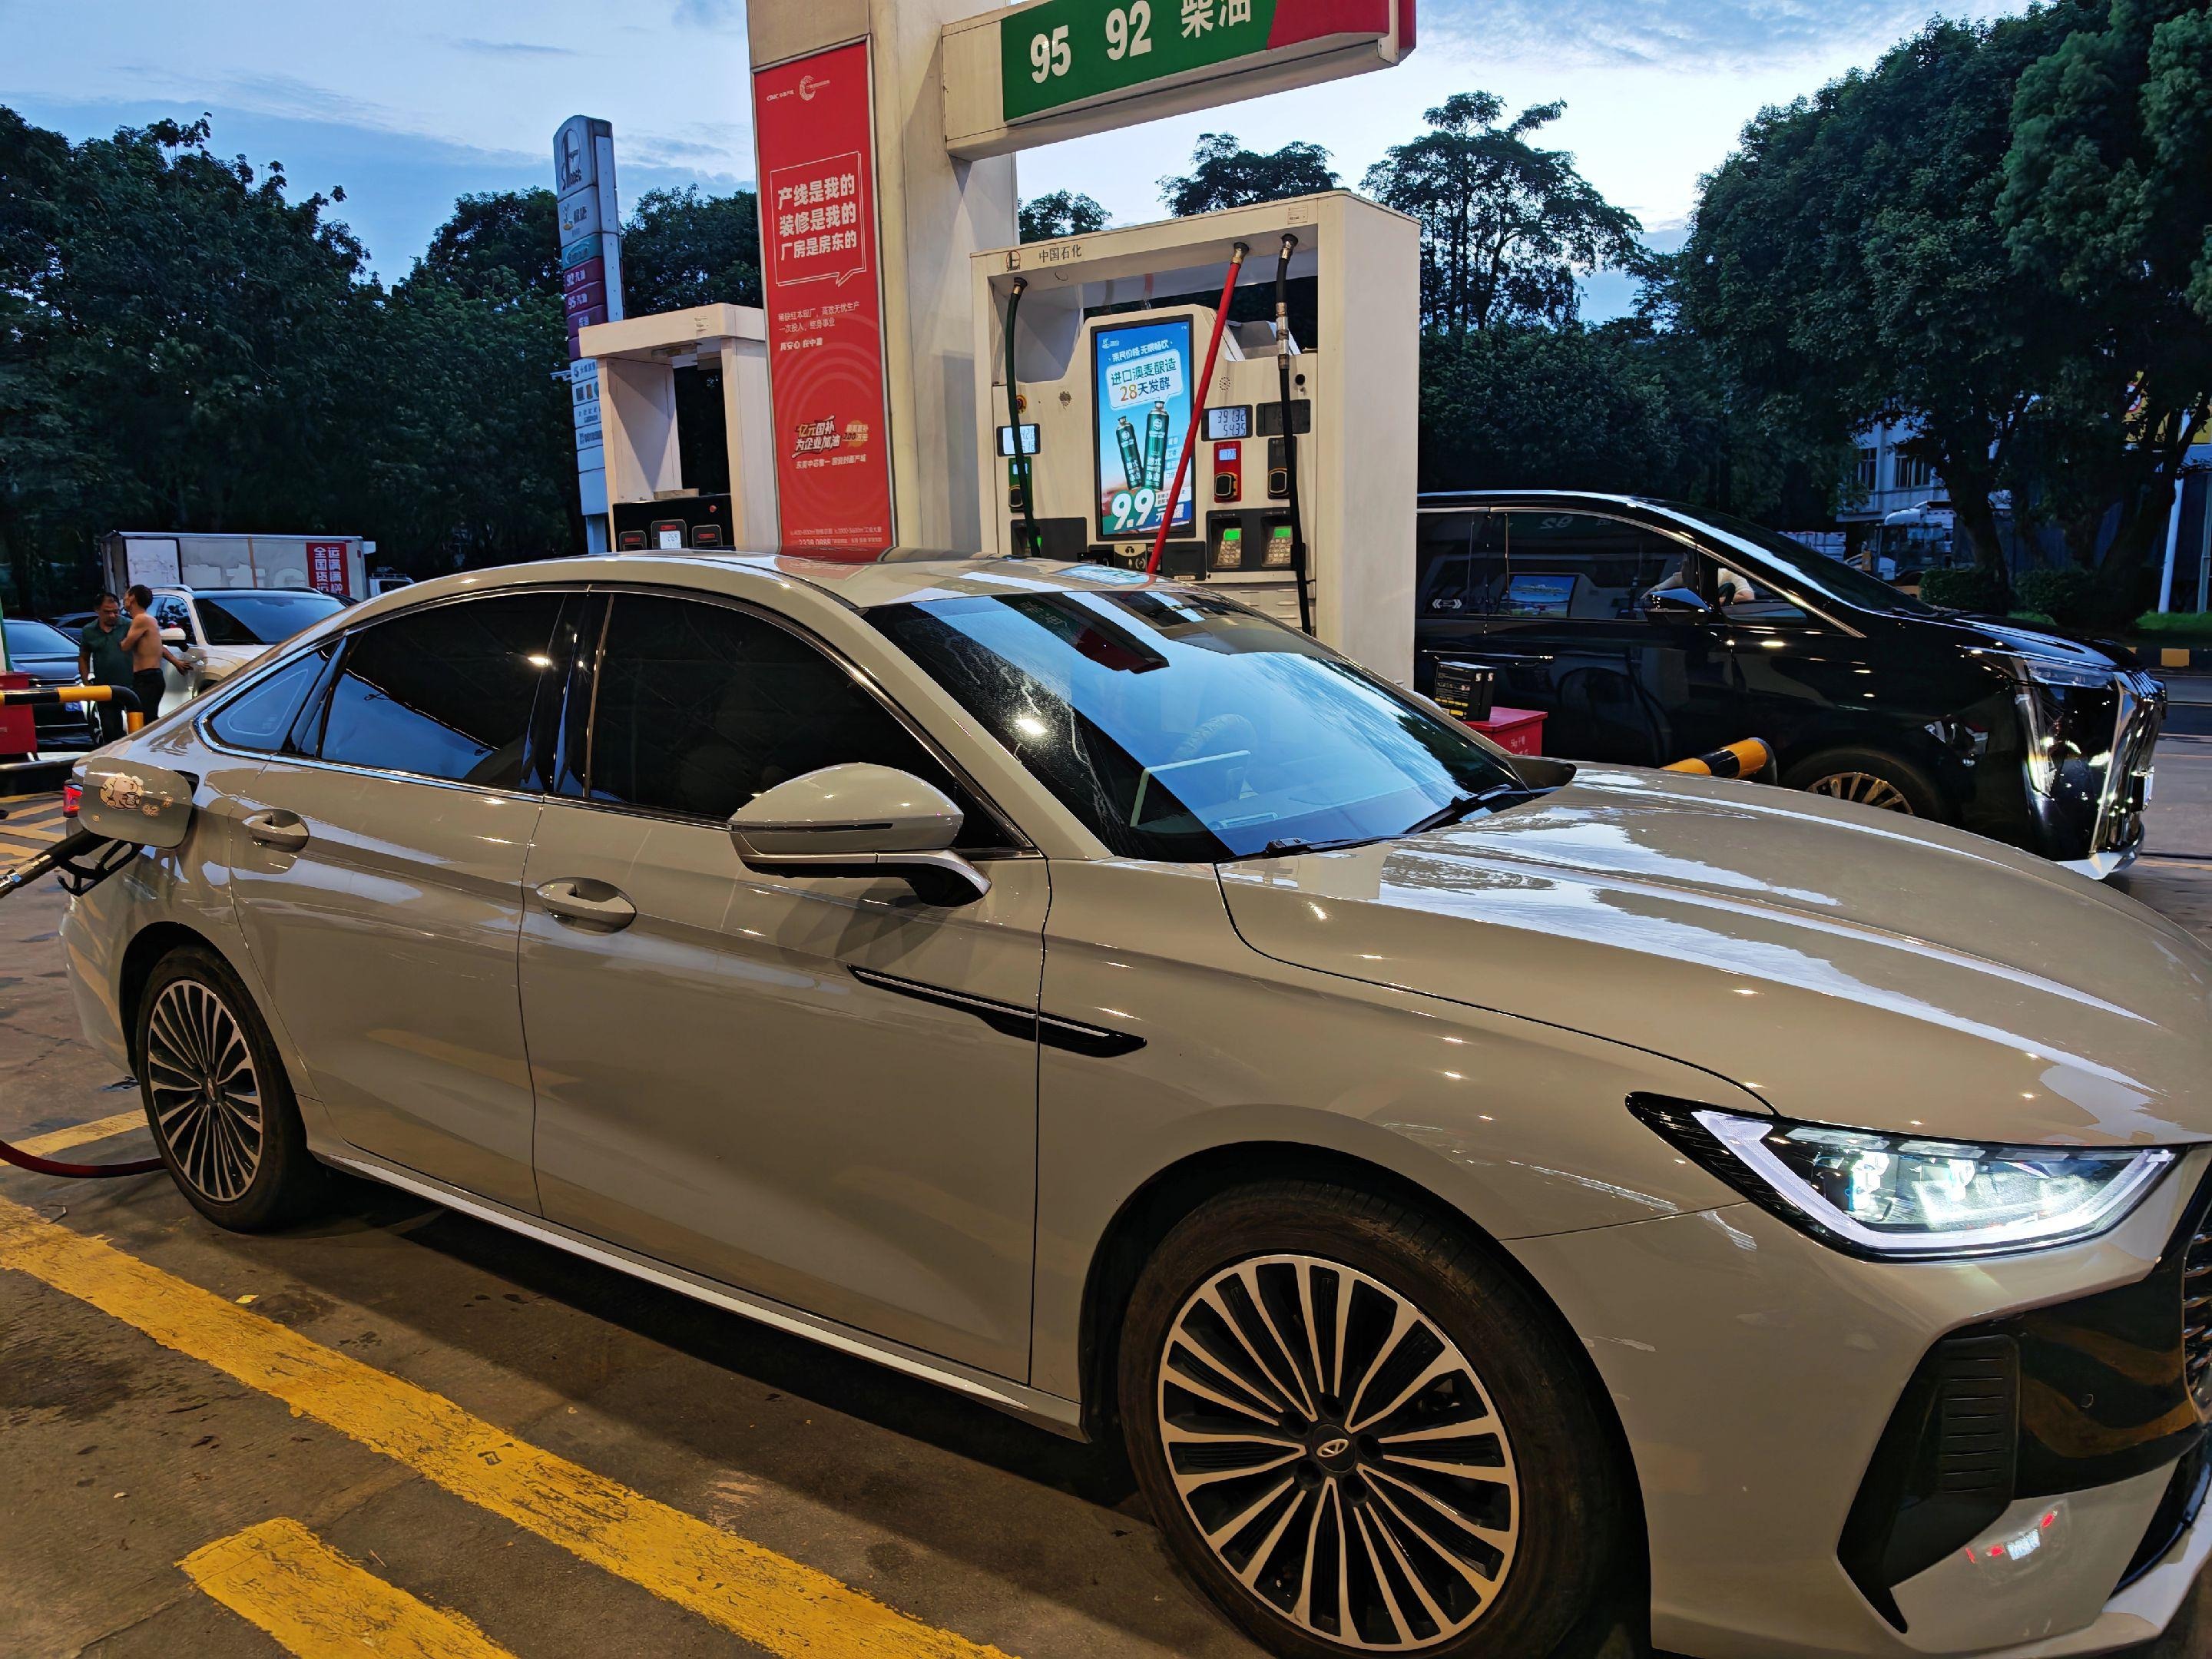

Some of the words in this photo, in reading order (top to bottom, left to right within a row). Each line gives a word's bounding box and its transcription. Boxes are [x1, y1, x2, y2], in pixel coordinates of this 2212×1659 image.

[1030, 25, 1071, 84] 95
[1105, 0, 1152, 61] 92
[778, 173, 856, 211] 产线是我的
[780, 201, 856, 238] 装修是我的
[780, 230, 857, 261] 厂房是房东的
[1039, 243, 1082, 263] 中国石化
[1111, 357, 1177, 386] 进口澳麦酿造
[1119, 376, 1171, 402] 28天发酵
[795, 433, 841, 452] 为企业加油
[1111, 488, 1155, 531] 9.9
